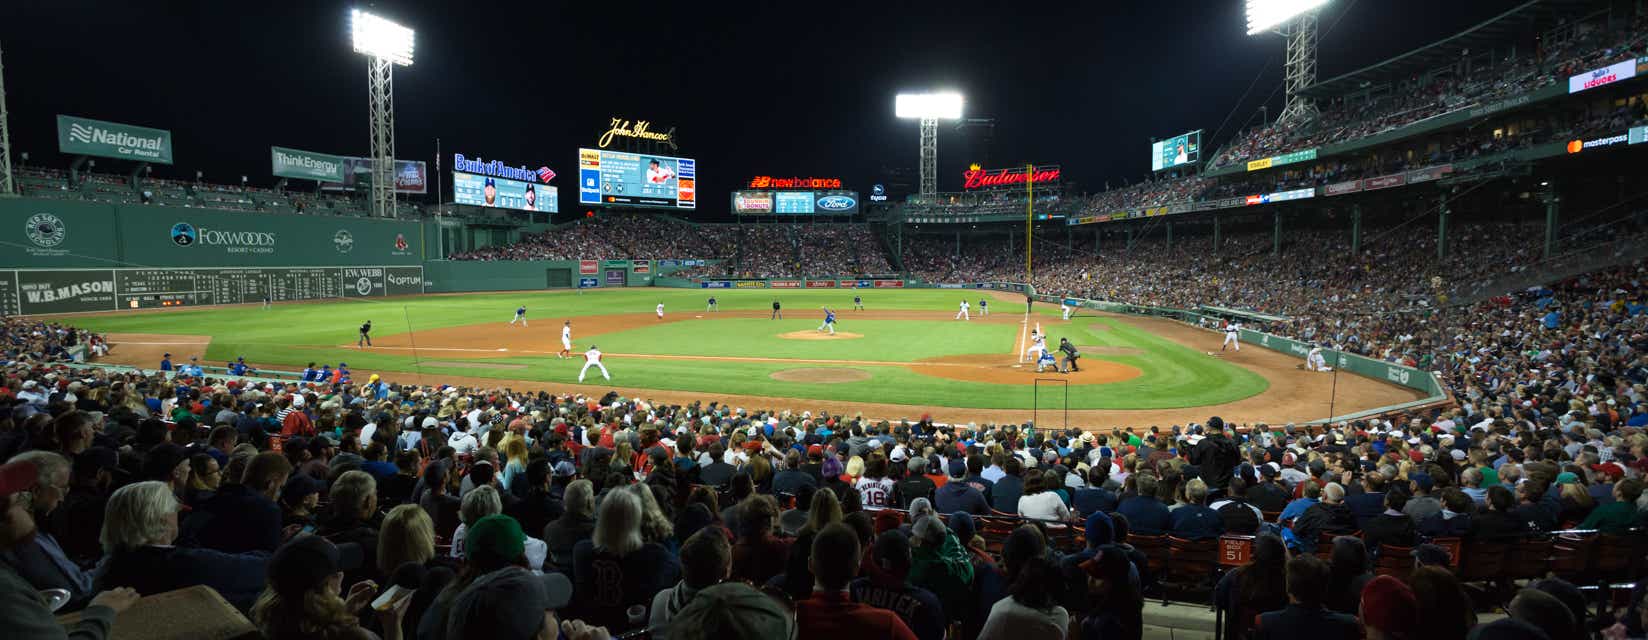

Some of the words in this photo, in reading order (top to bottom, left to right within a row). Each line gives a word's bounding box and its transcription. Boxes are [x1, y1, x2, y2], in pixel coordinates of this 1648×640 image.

[1584, 74, 1617, 89] LIQUORS
[92, 128, 162, 150] National
[598, 117, 632, 148] John
[1583, 134, 1628, 148] masterpass
[134, 149, 160, 158] Rental
[275, 152, 337, 173] ThinkEnergy
[454, 153, 486, 175] Bank
[485, 160, 498, 176] of
[497, 161, 537, 182] America
[824, 199, 848, 208] Ford
[198, 228, 276, 246] FOXWOODS
[395, 276, 421, 285] OPTUM
[1226, 550, 1242, 561] 51
